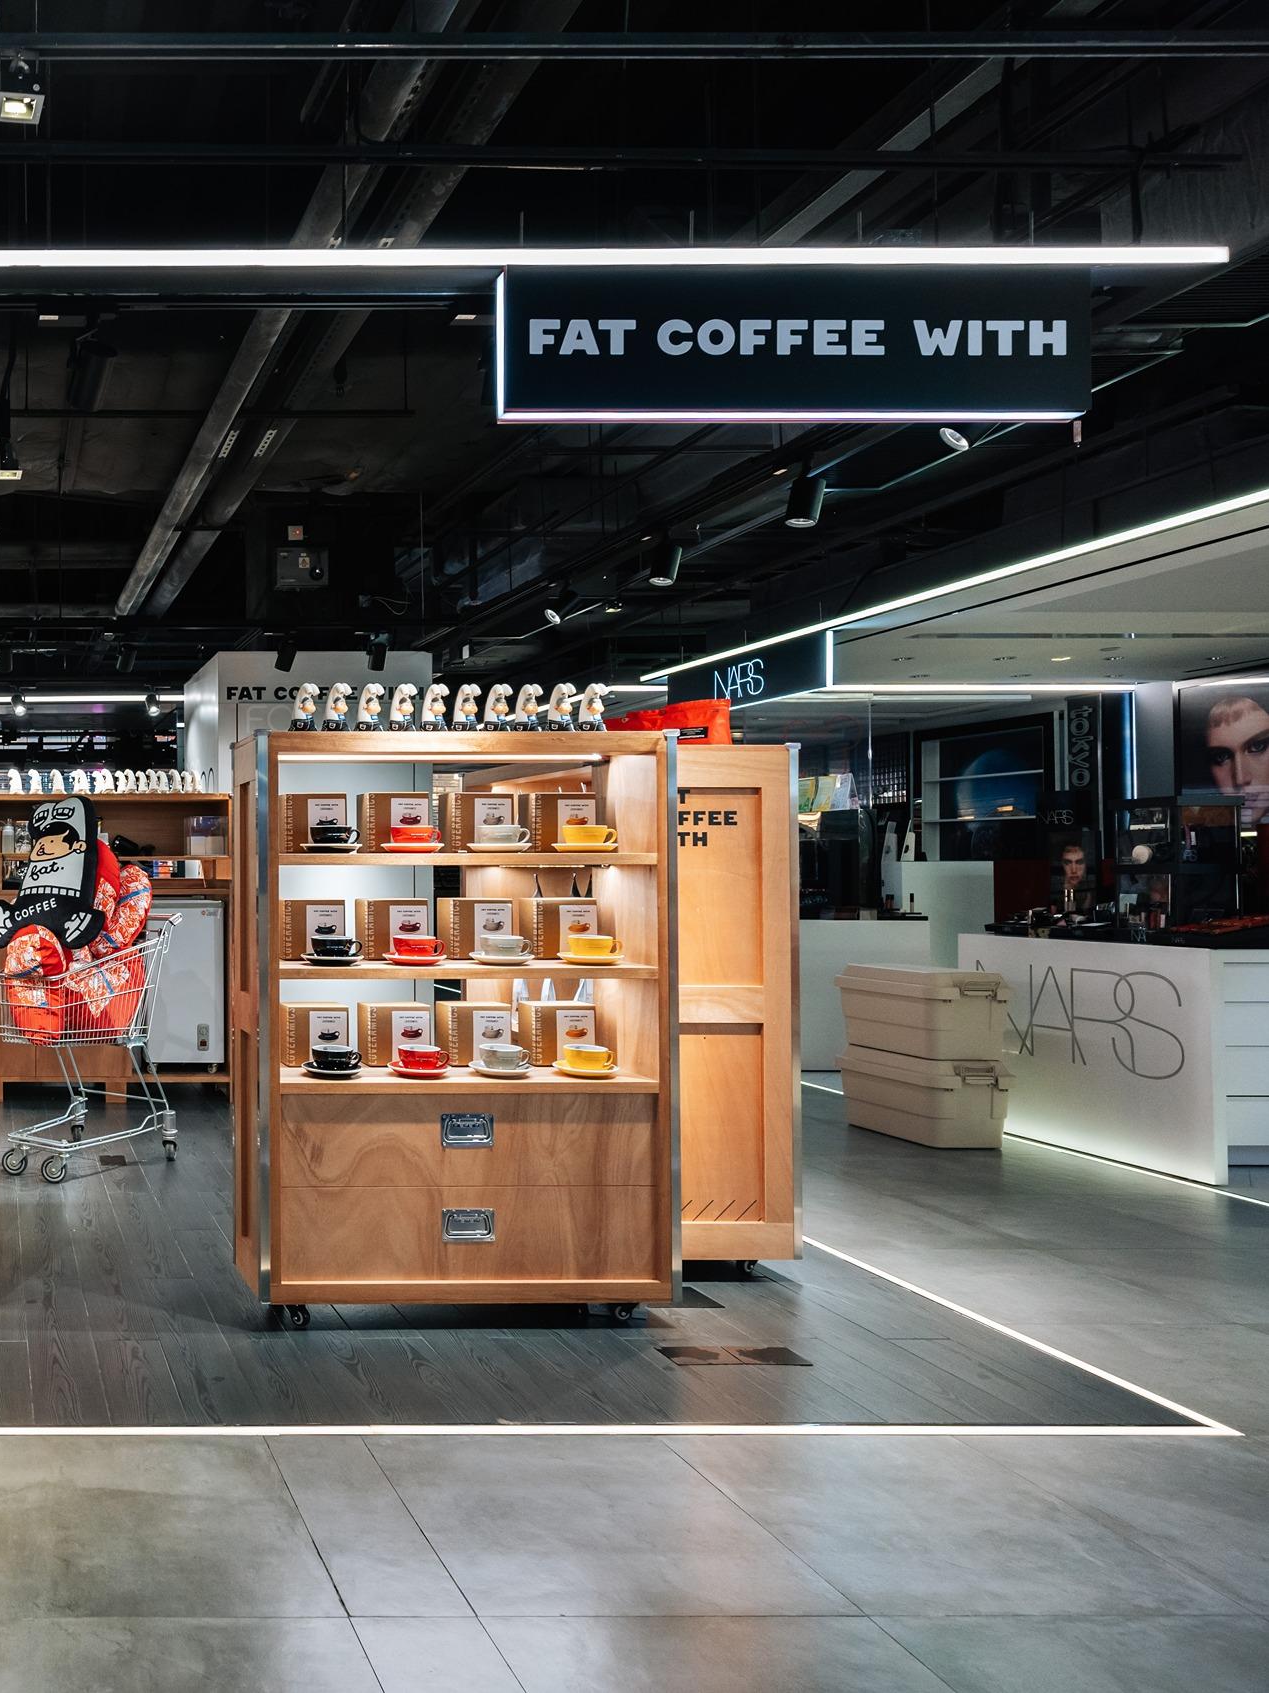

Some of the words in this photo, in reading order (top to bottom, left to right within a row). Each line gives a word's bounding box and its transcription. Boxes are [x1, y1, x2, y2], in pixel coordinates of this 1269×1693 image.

[529, 319, 636, 355] FAT
[656, 319, 885, 355] COFFEE
[913, 319, 1067, 356] WITH
[226, 686, 266, 700] FAT
[273, 686, 358, 700] COFE
[714, 658, 765, 700] NARS
[1070, 705, 1094, 787] tokyo
[29, 861, 64, 881] fat.
[14, 897, 58, 921] COFFEE
